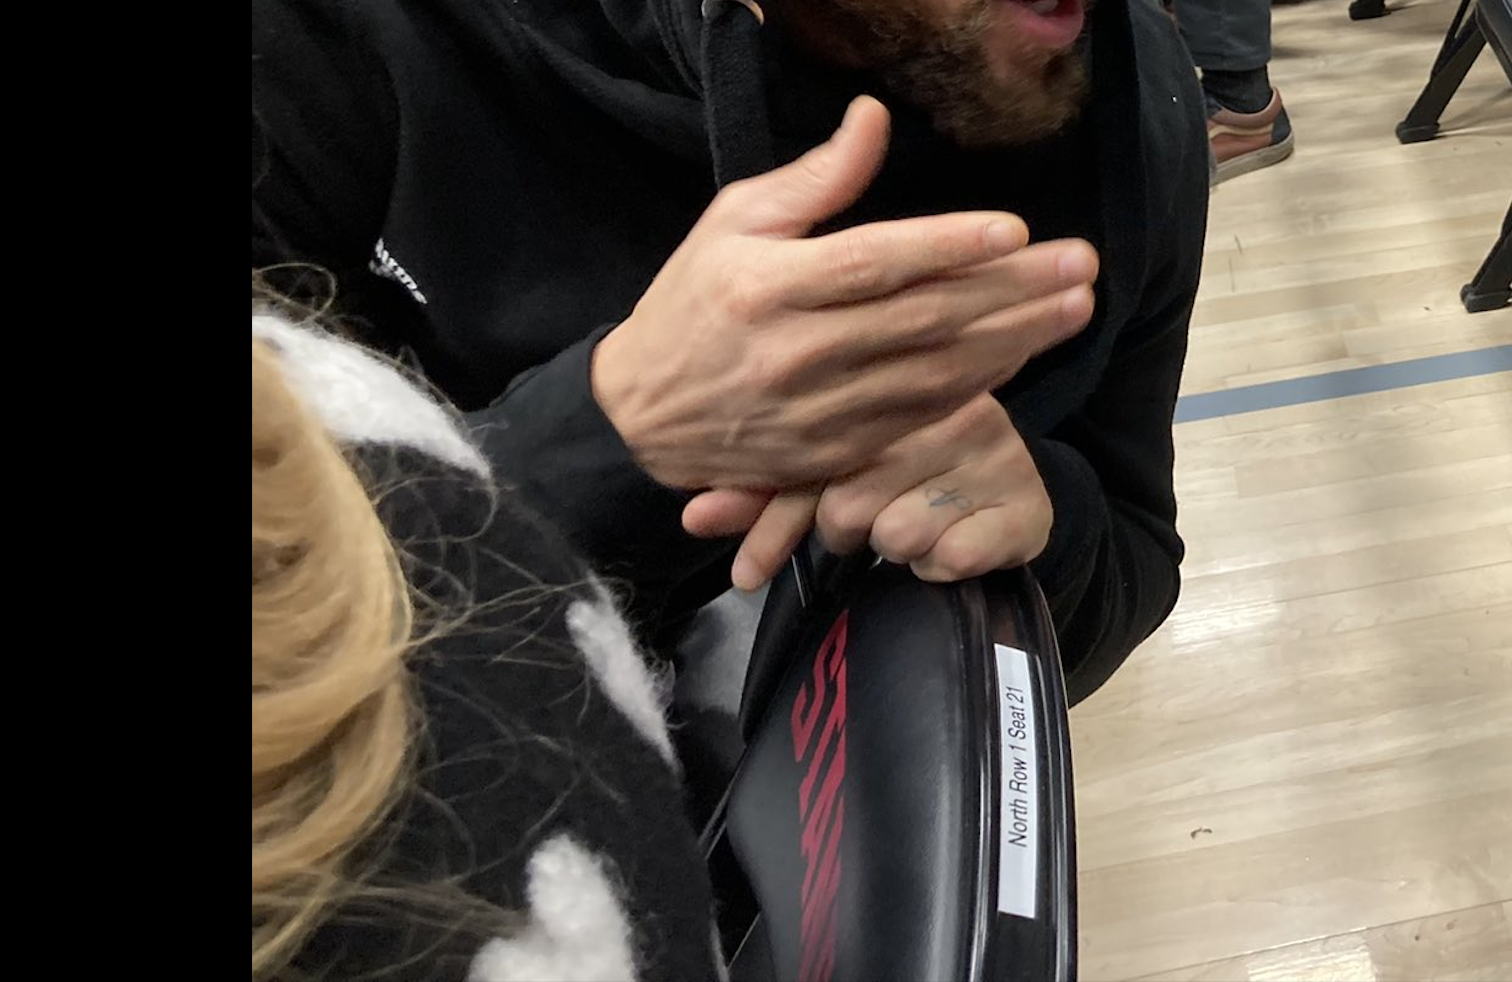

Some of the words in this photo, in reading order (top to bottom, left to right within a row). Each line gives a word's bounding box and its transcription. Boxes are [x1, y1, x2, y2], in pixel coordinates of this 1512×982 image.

[1006, 686, 1024, 702] 21
[1008, 704, 1026, 740] Seat
[1009, 744, 1027, 752] 1
[1009, 756, 1028, 794] Row
[1008, 797, 1027, 847] North
